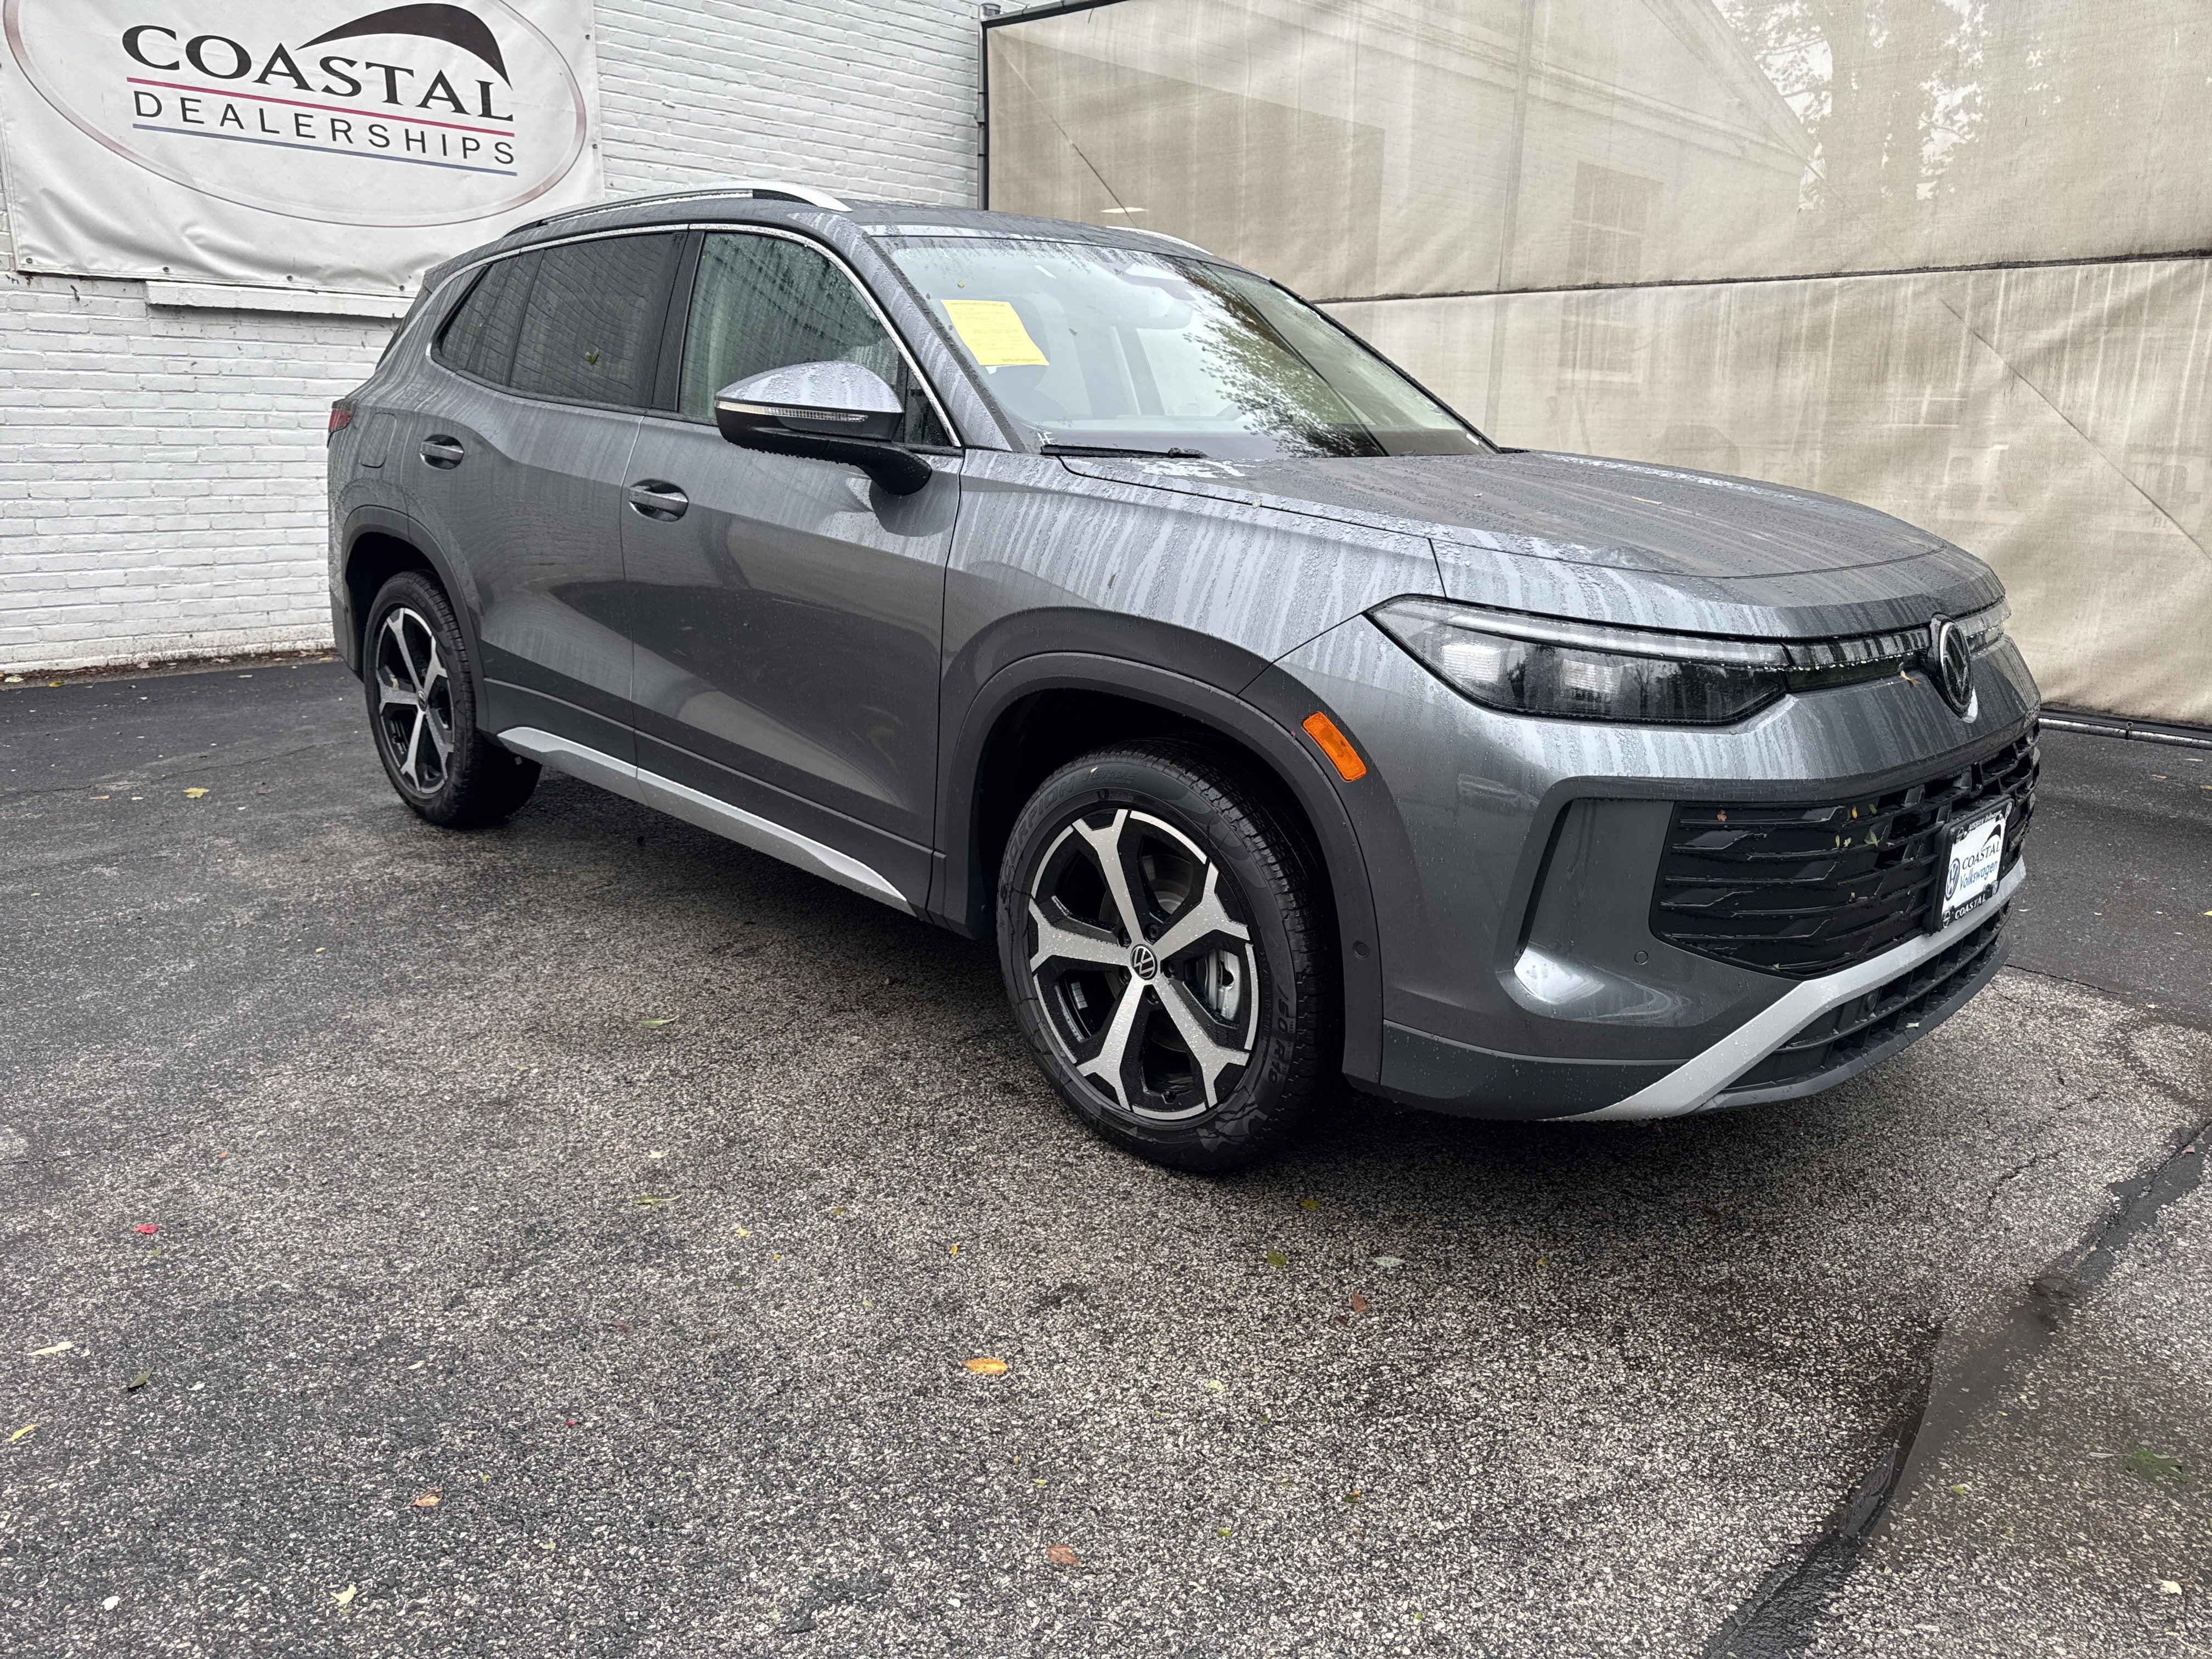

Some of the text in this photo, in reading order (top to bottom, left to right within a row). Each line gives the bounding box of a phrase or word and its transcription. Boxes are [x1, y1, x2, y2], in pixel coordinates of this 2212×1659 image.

[122, 24, 514, 122] COASTAL
[133, 90, 516, 165] DEALERSHIPS
[1962, 841, 2000, 870] COASTAL
[1960, 860, 1997, 890] Volkswagen
[1955, 894, 1986, 919] COASTAL
